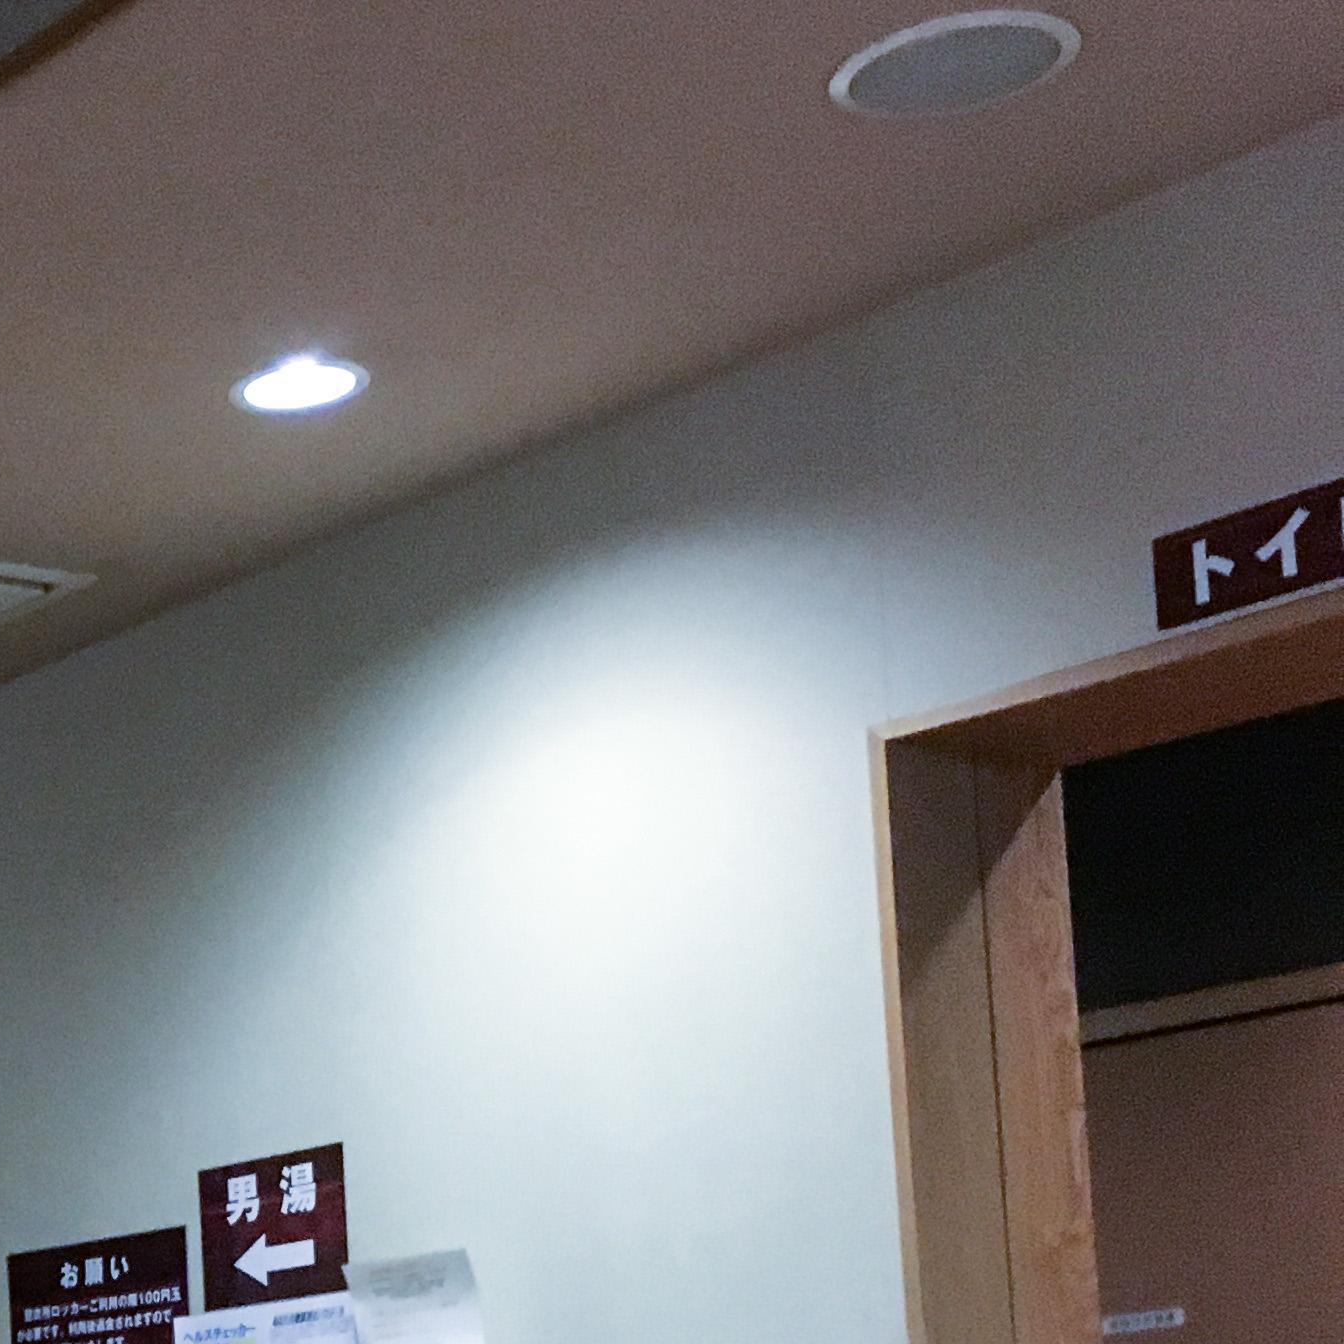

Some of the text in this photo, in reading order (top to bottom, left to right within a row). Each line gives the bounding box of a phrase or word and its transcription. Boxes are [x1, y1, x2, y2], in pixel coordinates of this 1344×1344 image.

[1192, 496, 1344, 605] トイ
[226, 1162, 316, 1226] 男湯
[60, 1256, 129, 1288] お願い
